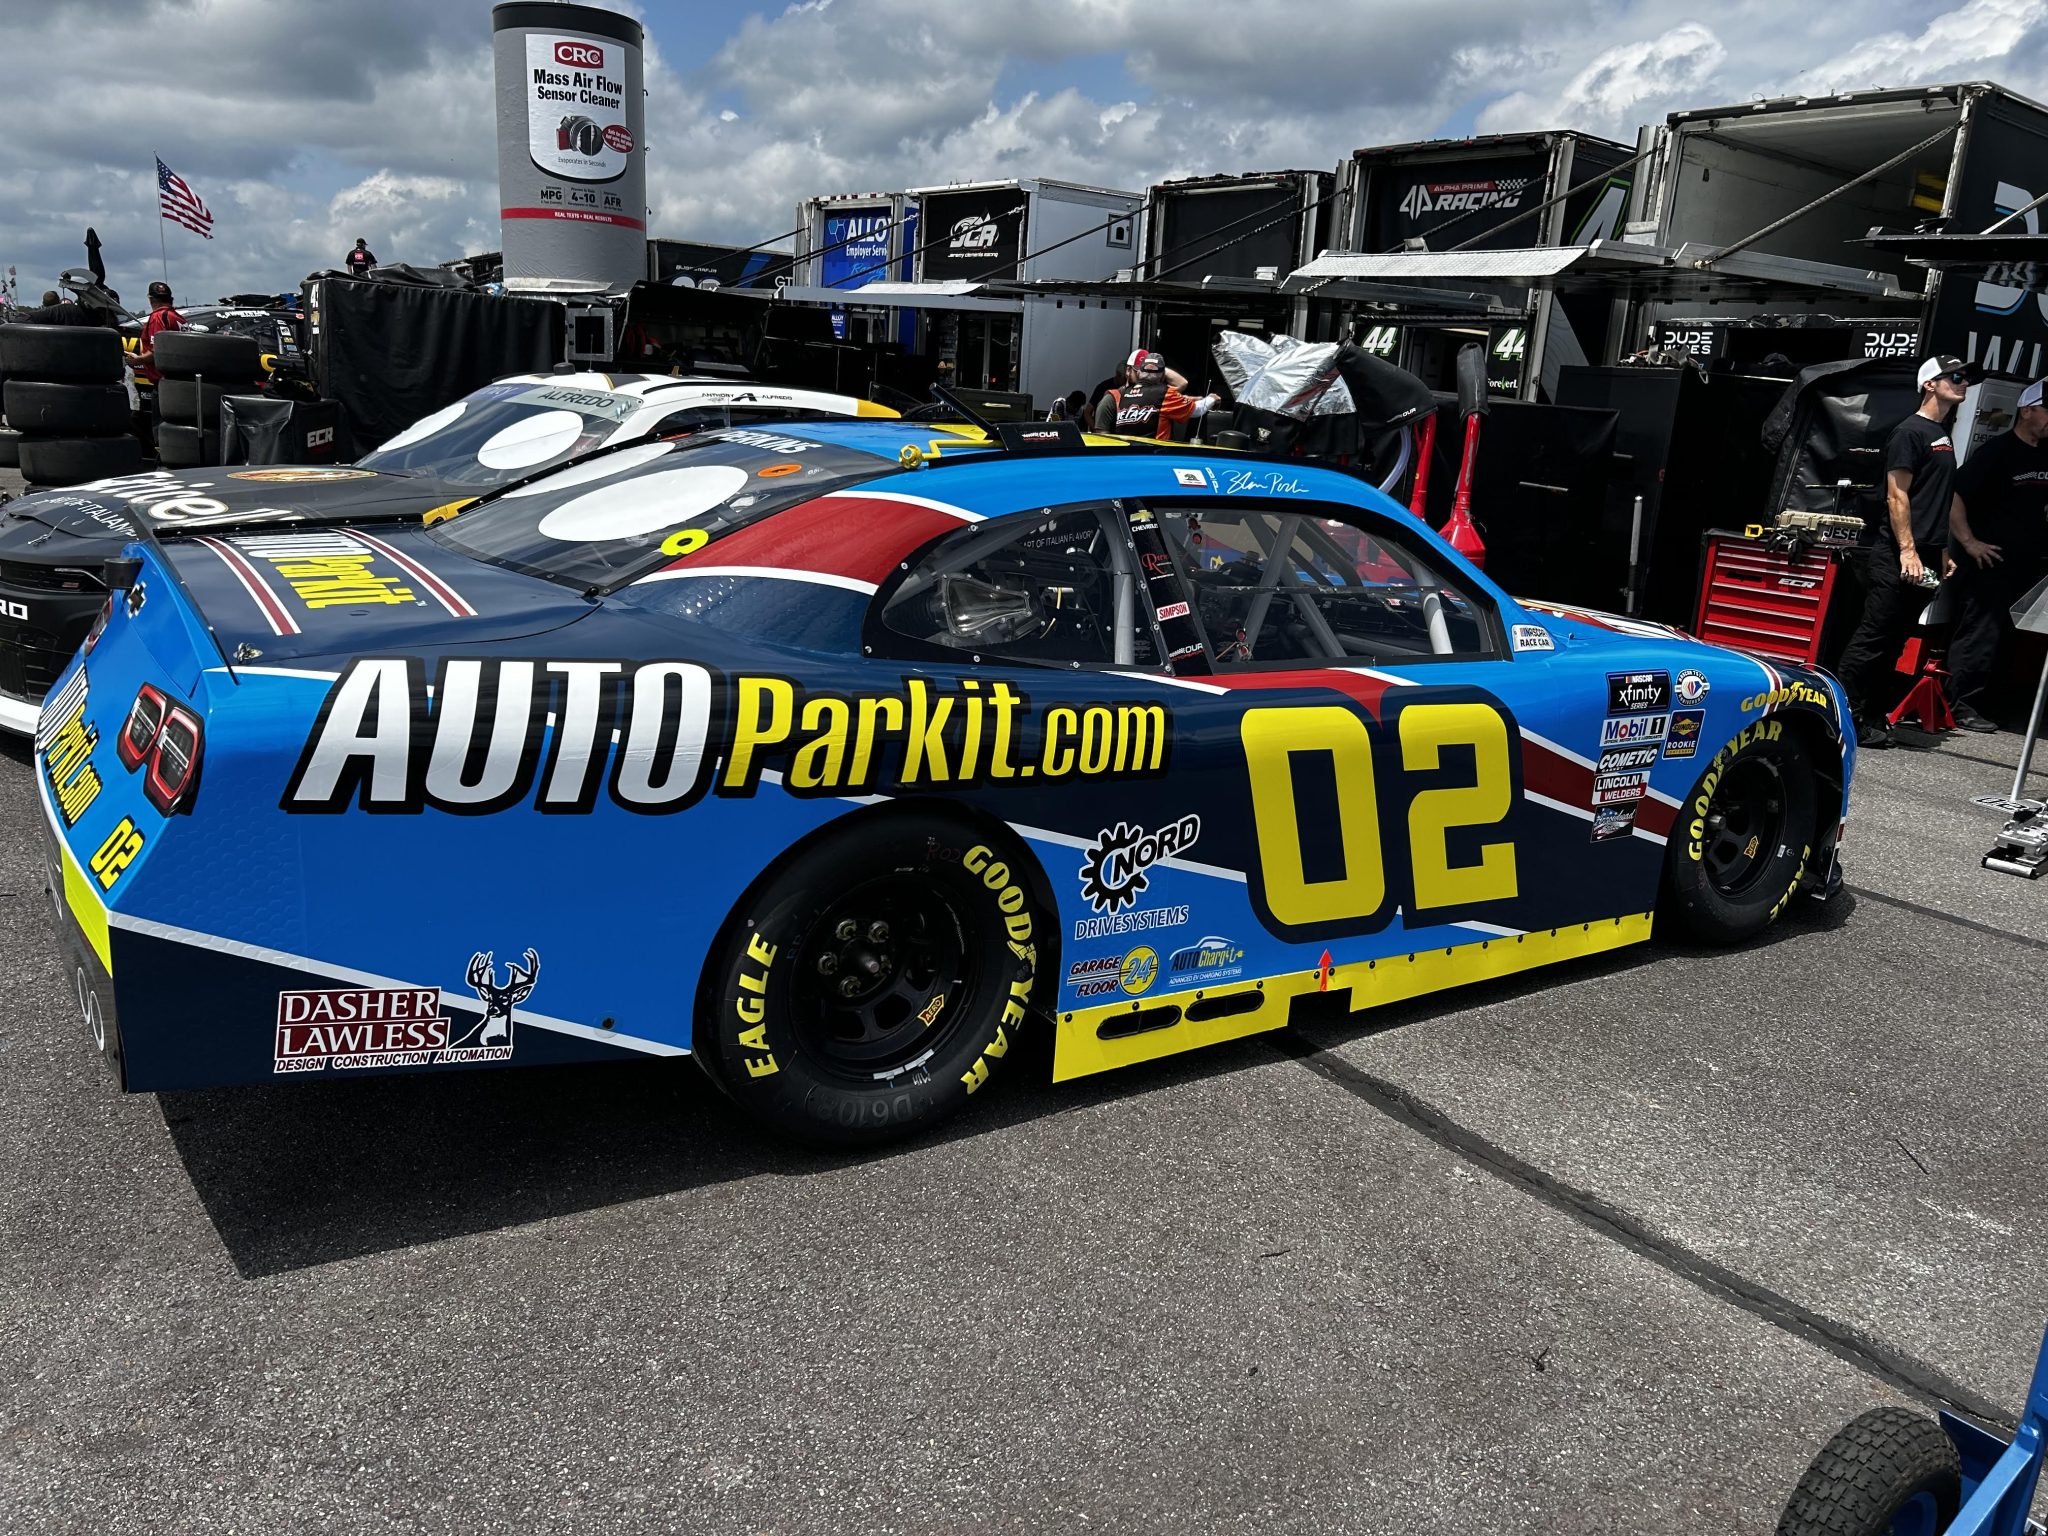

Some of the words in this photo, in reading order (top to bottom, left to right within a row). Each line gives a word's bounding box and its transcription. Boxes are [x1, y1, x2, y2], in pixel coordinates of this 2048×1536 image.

[557, 46, 601, 65] CRC
[534, 69, 570, 85] Mass
[573, 72, 593, 88] Air
[597, 76, 622, 95] Flow
[537, 86, 577, 102] Sensor
[580, 90, 620, 109] Cleaner
[540, 189, 562, 200] MPG
[1433, 184, 1460, 192] ALPHA
[1461, 182, 1489, 191] PRIME
[571, 192, 596, 204] 4-10
[603, 195, 621, 208] AFR
[1435, 191, 1522, 211] RACING
[846, 245, 872, 260] Employer
[1362, 326, 1397, 354] 44
[1664, 331, 1713, 344] DUDE
[1865, 333, 1918, 347] DUDE
[537, 391, 615, 408] ALFREDO
[307, 427, 334, 448] ECR
[1045, 533, 1069, 547] ITALIAN
[1778, 578, 1816, 589] ECR
[1159, 604, 1189, 620] SIMPSON
[1524, 627, 1547, 638] NASCAR
[1519, 639, 1537, 648] RACE
[1537, 638, 1549, 647] CAR
[1632, 674, 1653, 683] NASCAR
[1619, 684, 1662, 706] xfinity
[1741, 681, 1828, 713] GOODYEAR
[1630, 702, 1649, 710] SERIES
[1604, 718, 1649, 740] Mobil
[1655, 718, 1662, 734] 1
[1672, 723, 1700, 732] SUNOCO
[1667, 740, 1696, 749] ROOKIE
[1599, 749, 1658, 770] COMETIC
[1596, 775, 1640, 791] LINCOLN
[1688, 720, 1782, 861] GOODYEAR
[1604, 788, 1641, 801] WELDERS
[1241, 703, 1518, 926] 02
[90, 818, 144, 890] 02
[1112, 815, 1199, 883] NORD
[1074, 905, 1189, 940] DRIVESYSTEMS
[961, 845, 1036, 1095] GOODYEAR
[1070, 956, 1122, 975] GARAGE
[1124, 956, 1155, 986] 24
[1200, 972, 1222, 980] CHARGING
[1222, 968, 1242, 977] SYSTEMS
[1076, 979, 1118, 997] FLOOR
[283, 991, 437, 1023] DASHER
[736, 932, 779, 1078] EAGLE
[924, 998, 942, 1022] AERO
[281, 1021, 447, 1055] LAWLESS
[276, 1056, 326, 1072] DESIGN
[333, 1051, 429, 1069] CONSTRUCTION
[435, 1047, 512, 1064] AUTOMATION
